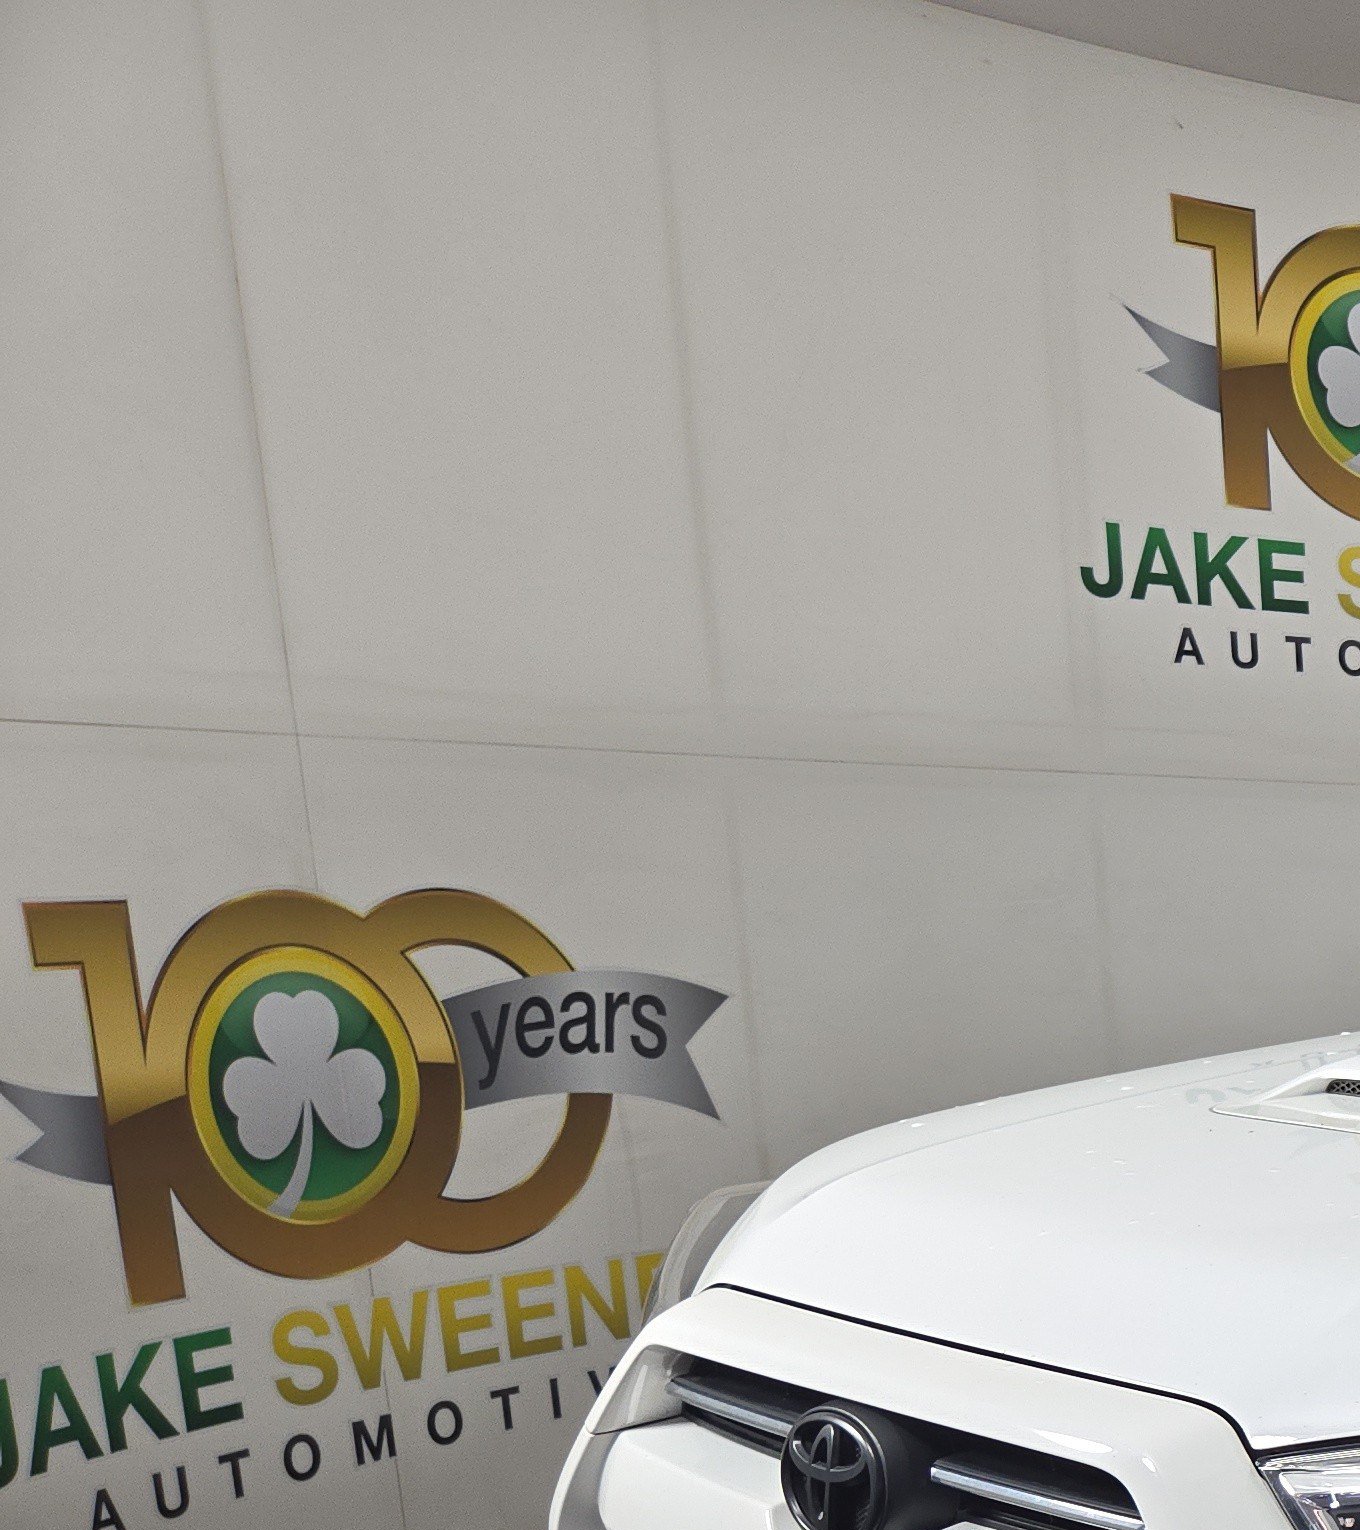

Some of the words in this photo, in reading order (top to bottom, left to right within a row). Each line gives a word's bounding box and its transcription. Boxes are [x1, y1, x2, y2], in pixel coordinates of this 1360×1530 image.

[1079, 520, 1310, 615] JAKE
[22, 887, 614, 1306] 100
[471, 988, 668, 1090] years
